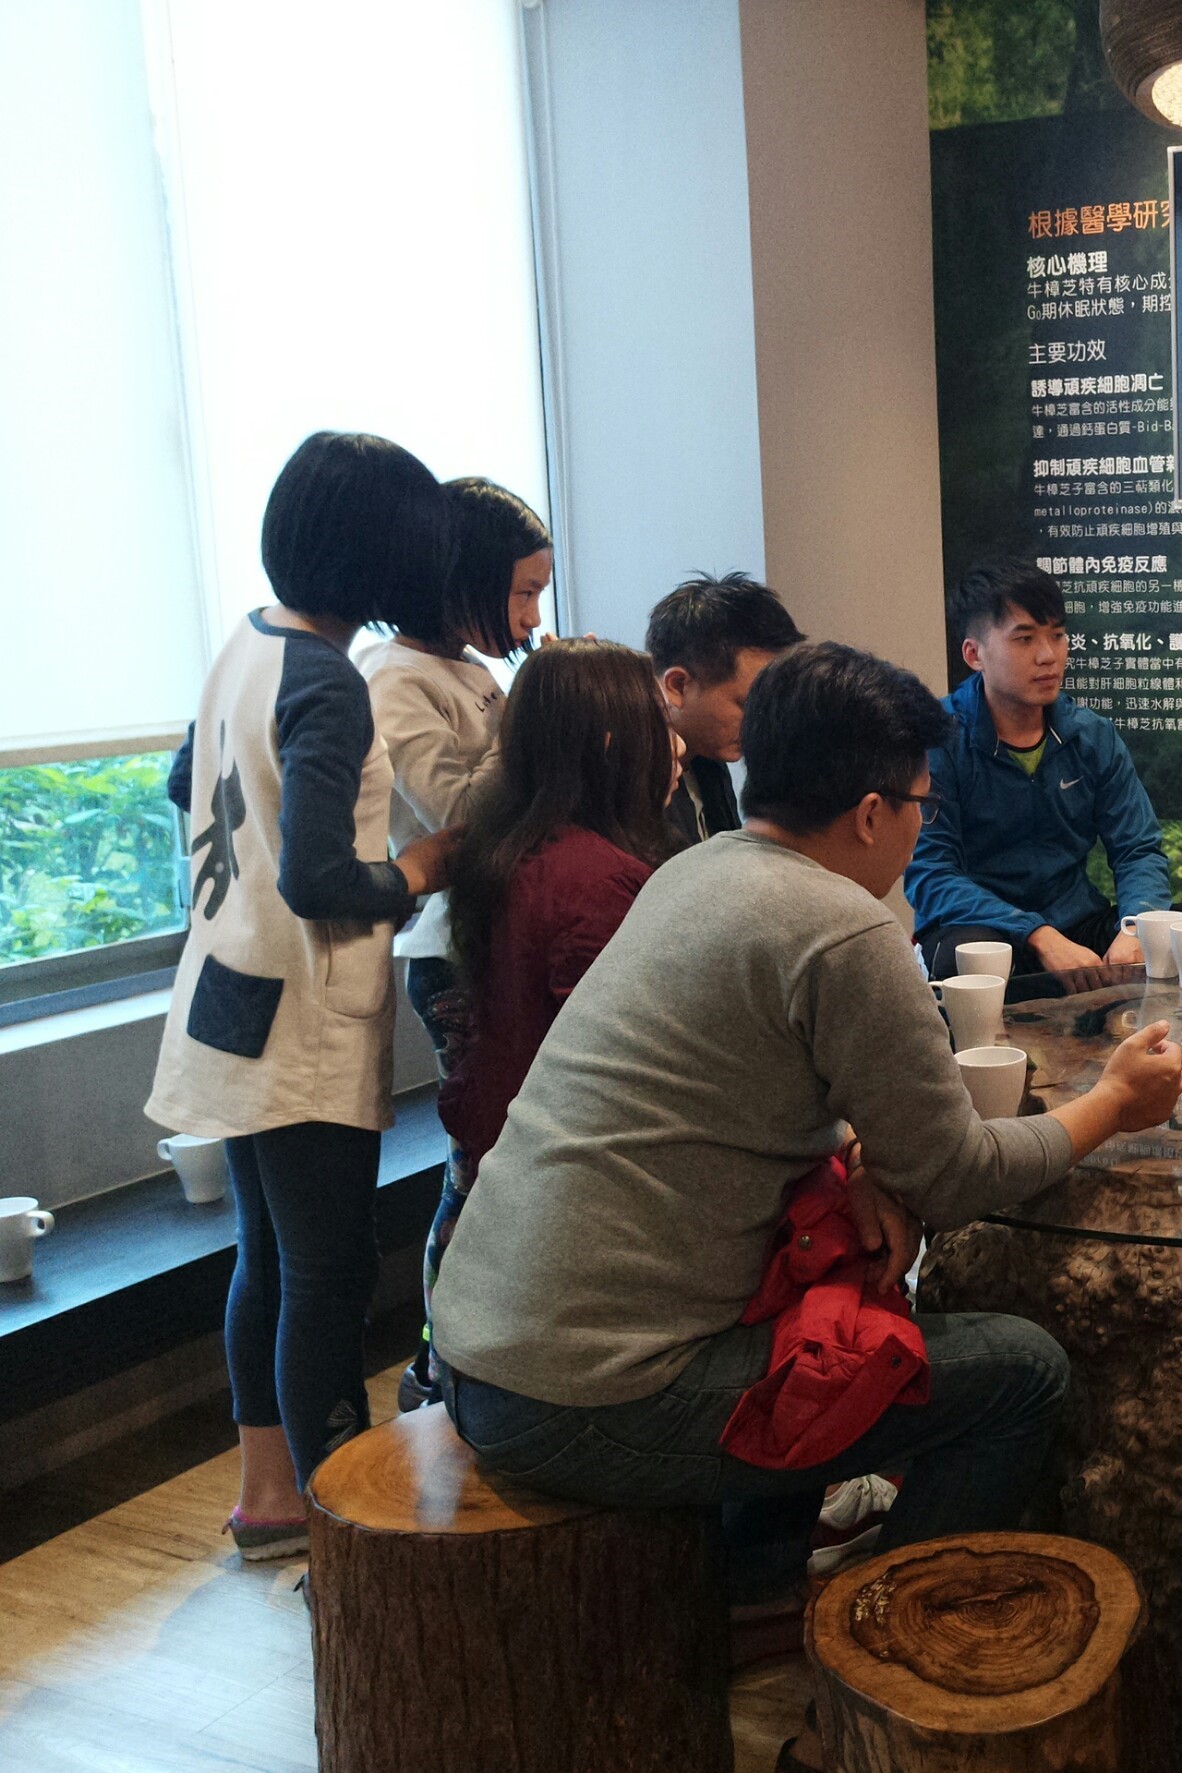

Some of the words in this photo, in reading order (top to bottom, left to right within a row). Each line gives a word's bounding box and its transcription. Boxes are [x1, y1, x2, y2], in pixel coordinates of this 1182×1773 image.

[1027, 251, 1108, 279] 核心機理
[1027, 272, 1171, 299] 牛樟芝特有核心成
[1028, 339, 1107, 365] 主要功效
[1032, 397, 1173, 418] 牛樟芝富含的活性成分能
